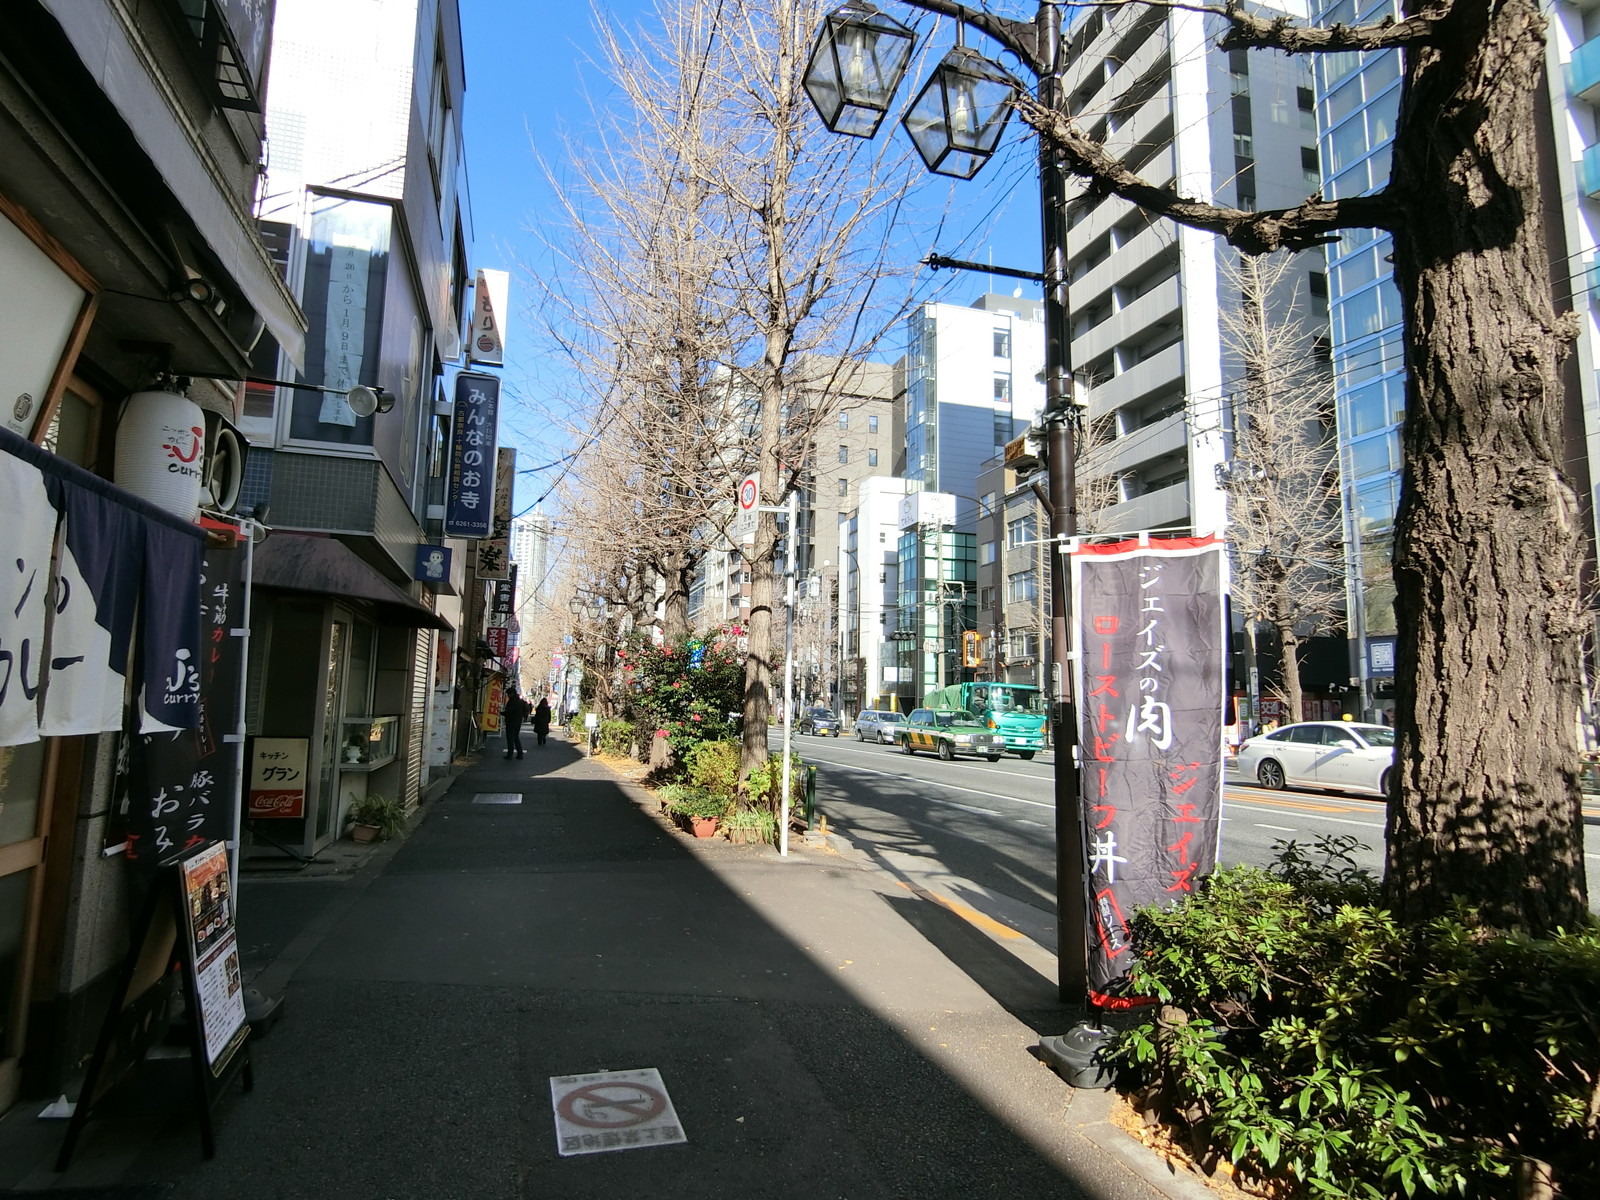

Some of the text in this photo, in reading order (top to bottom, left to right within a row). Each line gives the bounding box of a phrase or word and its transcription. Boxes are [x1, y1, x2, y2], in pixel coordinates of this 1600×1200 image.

[460, 388, 486, 509] みんなのお寺
[744, 487, 754, 502] 30
[163, 692, 200, 705] curry
[260, 751, 289, 760] キッチン
[1089, 614, 1128, 885] ローストビーフ丼
[262, 766, 300, 781] グラン
